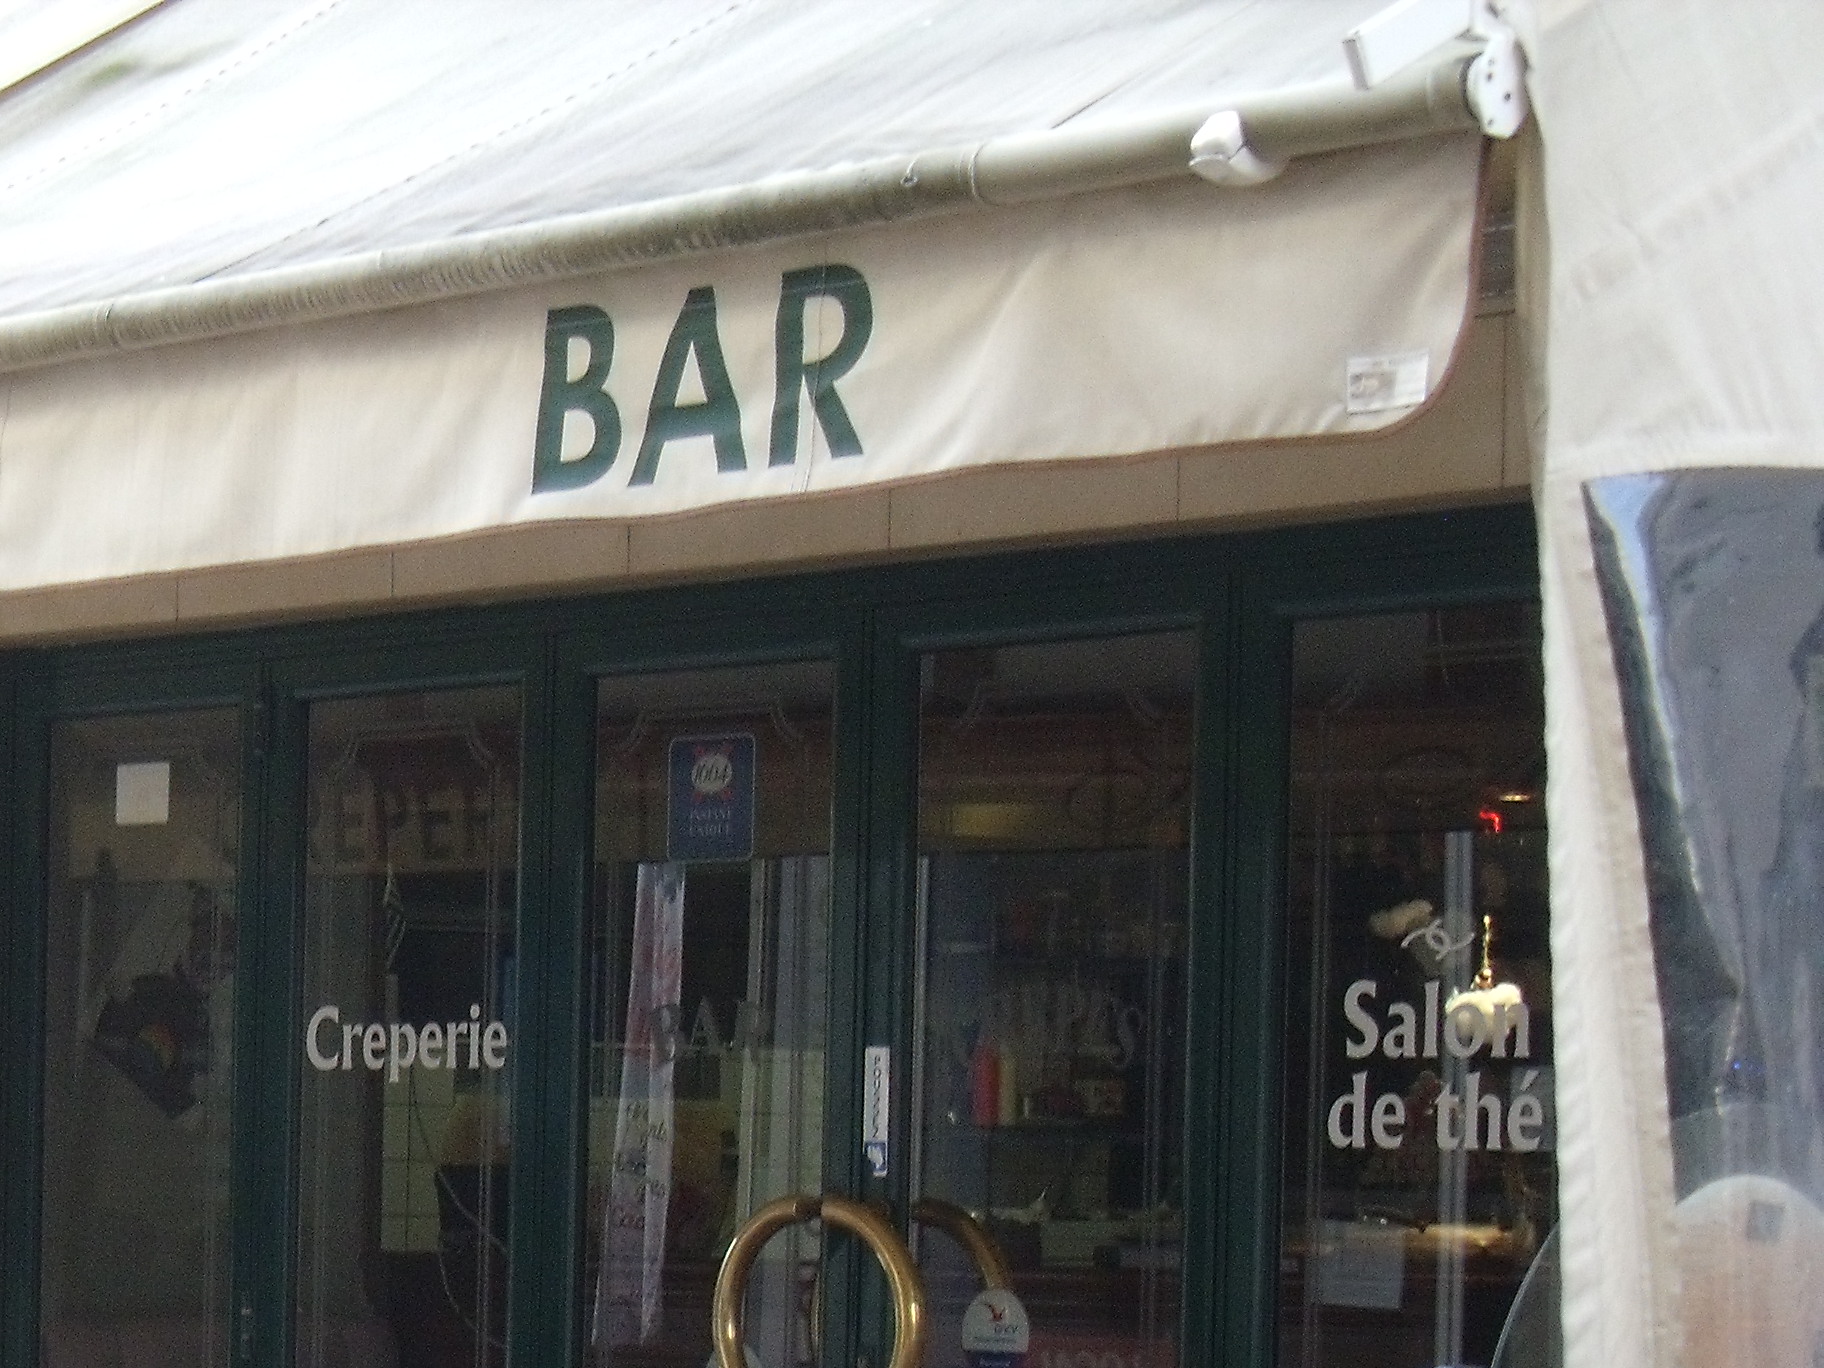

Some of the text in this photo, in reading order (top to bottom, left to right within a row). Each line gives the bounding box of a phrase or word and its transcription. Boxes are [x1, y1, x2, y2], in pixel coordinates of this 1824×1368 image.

[531, 263, 874, 496] BAR
[306, 1003, 508, 1083] Creperie
[1344, 978, 1530, 1060] Salon
[1327, 1069, 1543, 1151] de thé
